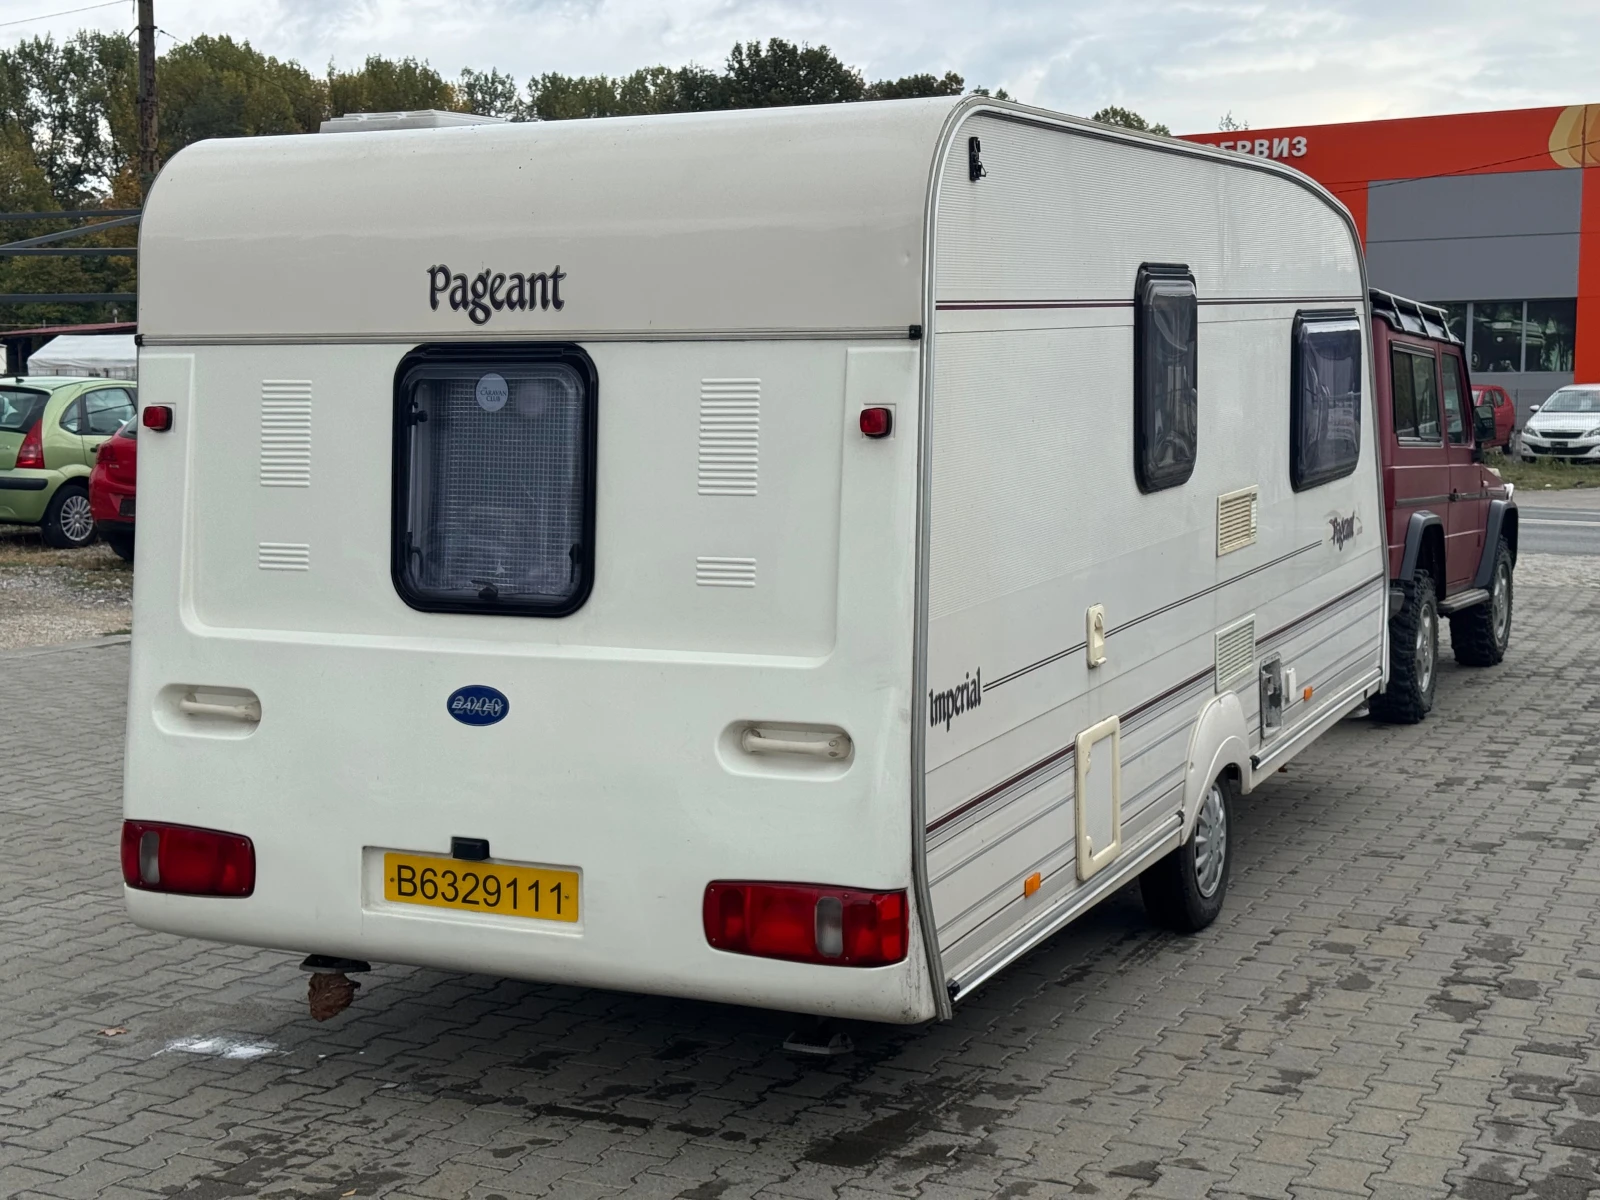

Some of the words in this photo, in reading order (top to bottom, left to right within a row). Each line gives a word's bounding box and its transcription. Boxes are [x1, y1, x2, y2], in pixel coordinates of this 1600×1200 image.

[1203, 136, 1308, 159] РВИЗ
[426, 264, 567, 326] Pageant
[480, 389, 507, 397] CARAVAN
[451, 700, 504, 712] BAILEY
[929, 666, 982, 733] Imperial
[397, 864, 561, 915] B6329111
